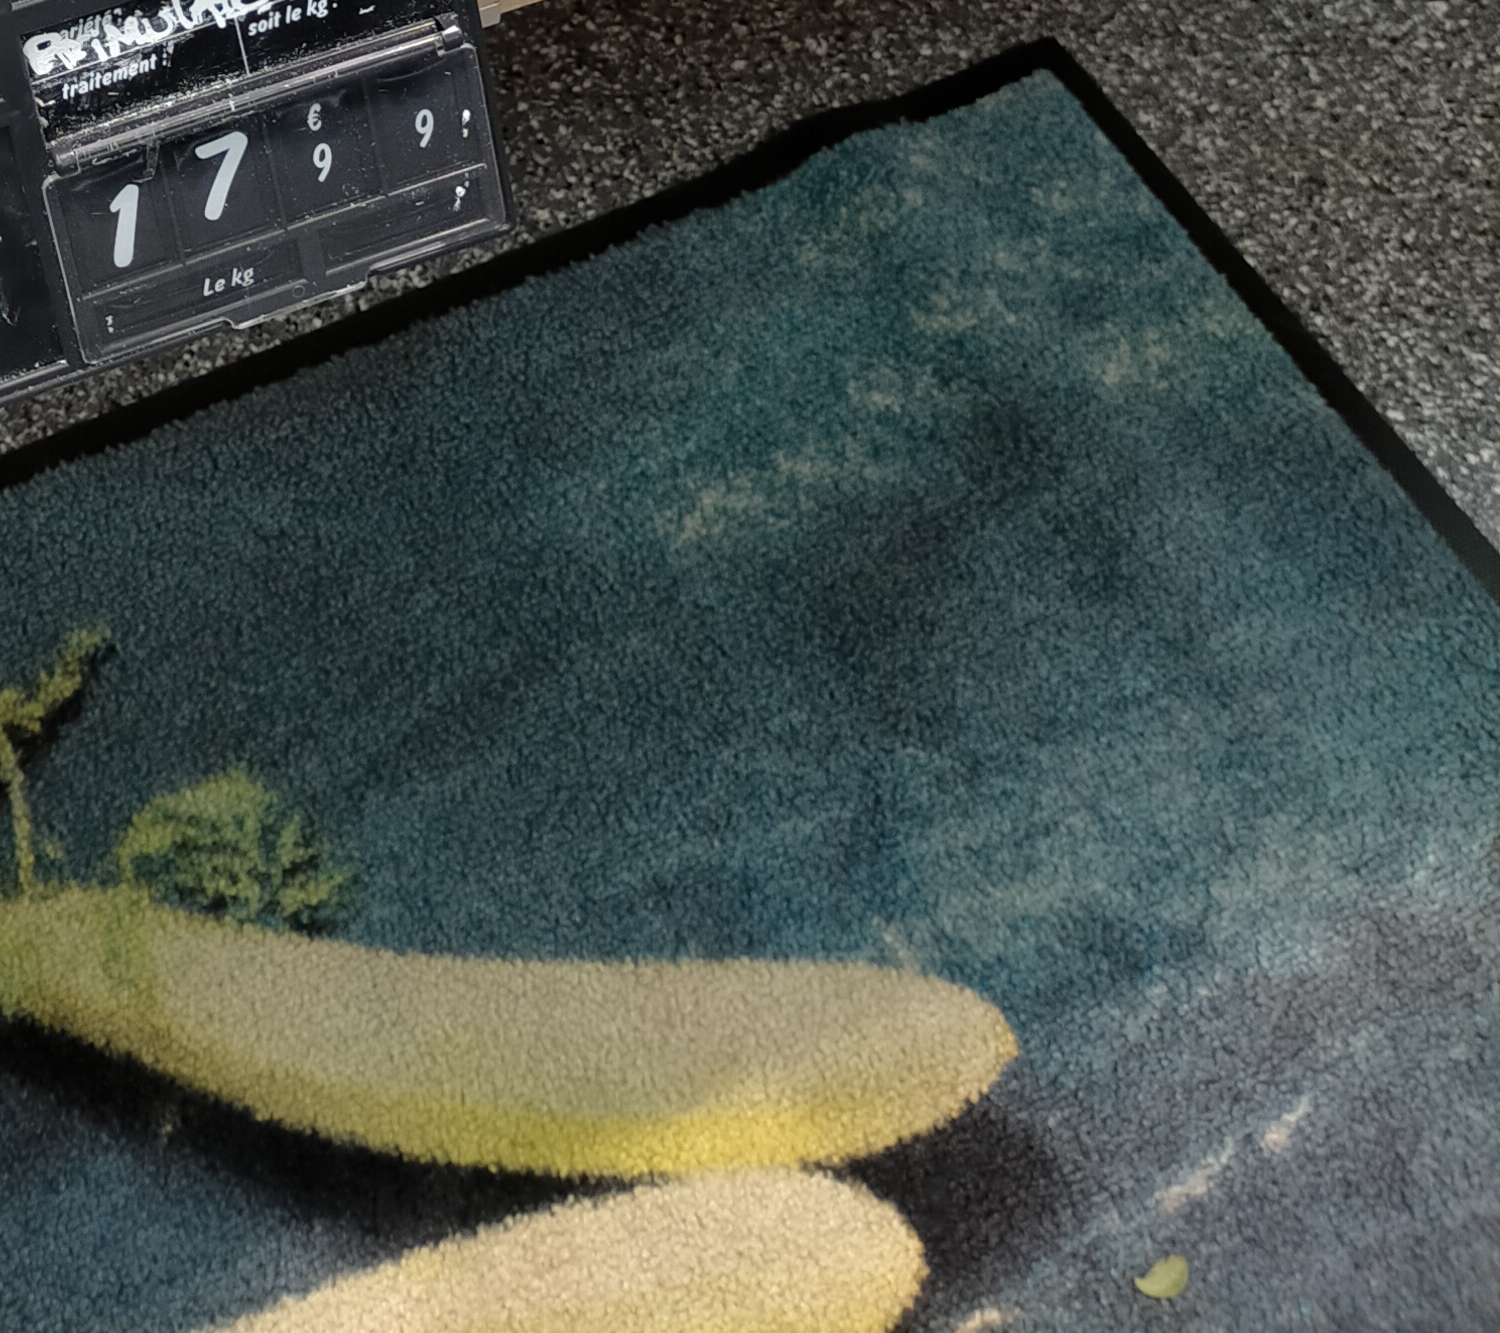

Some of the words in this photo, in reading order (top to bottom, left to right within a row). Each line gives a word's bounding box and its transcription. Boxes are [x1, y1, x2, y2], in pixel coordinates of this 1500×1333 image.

[248, 13, 282, 37] soit
[286, 7, 302, 26] le
[62, 53, 157, 101] traitement
[109, 184, 139, 268] 1
[194, 131, 248, 221] 7
[313, 143, 332, 182] 9
[415, 109, 434, 148] 9
[203, 277, 226, 297] Le
[231, 267, 254, 289] kg
